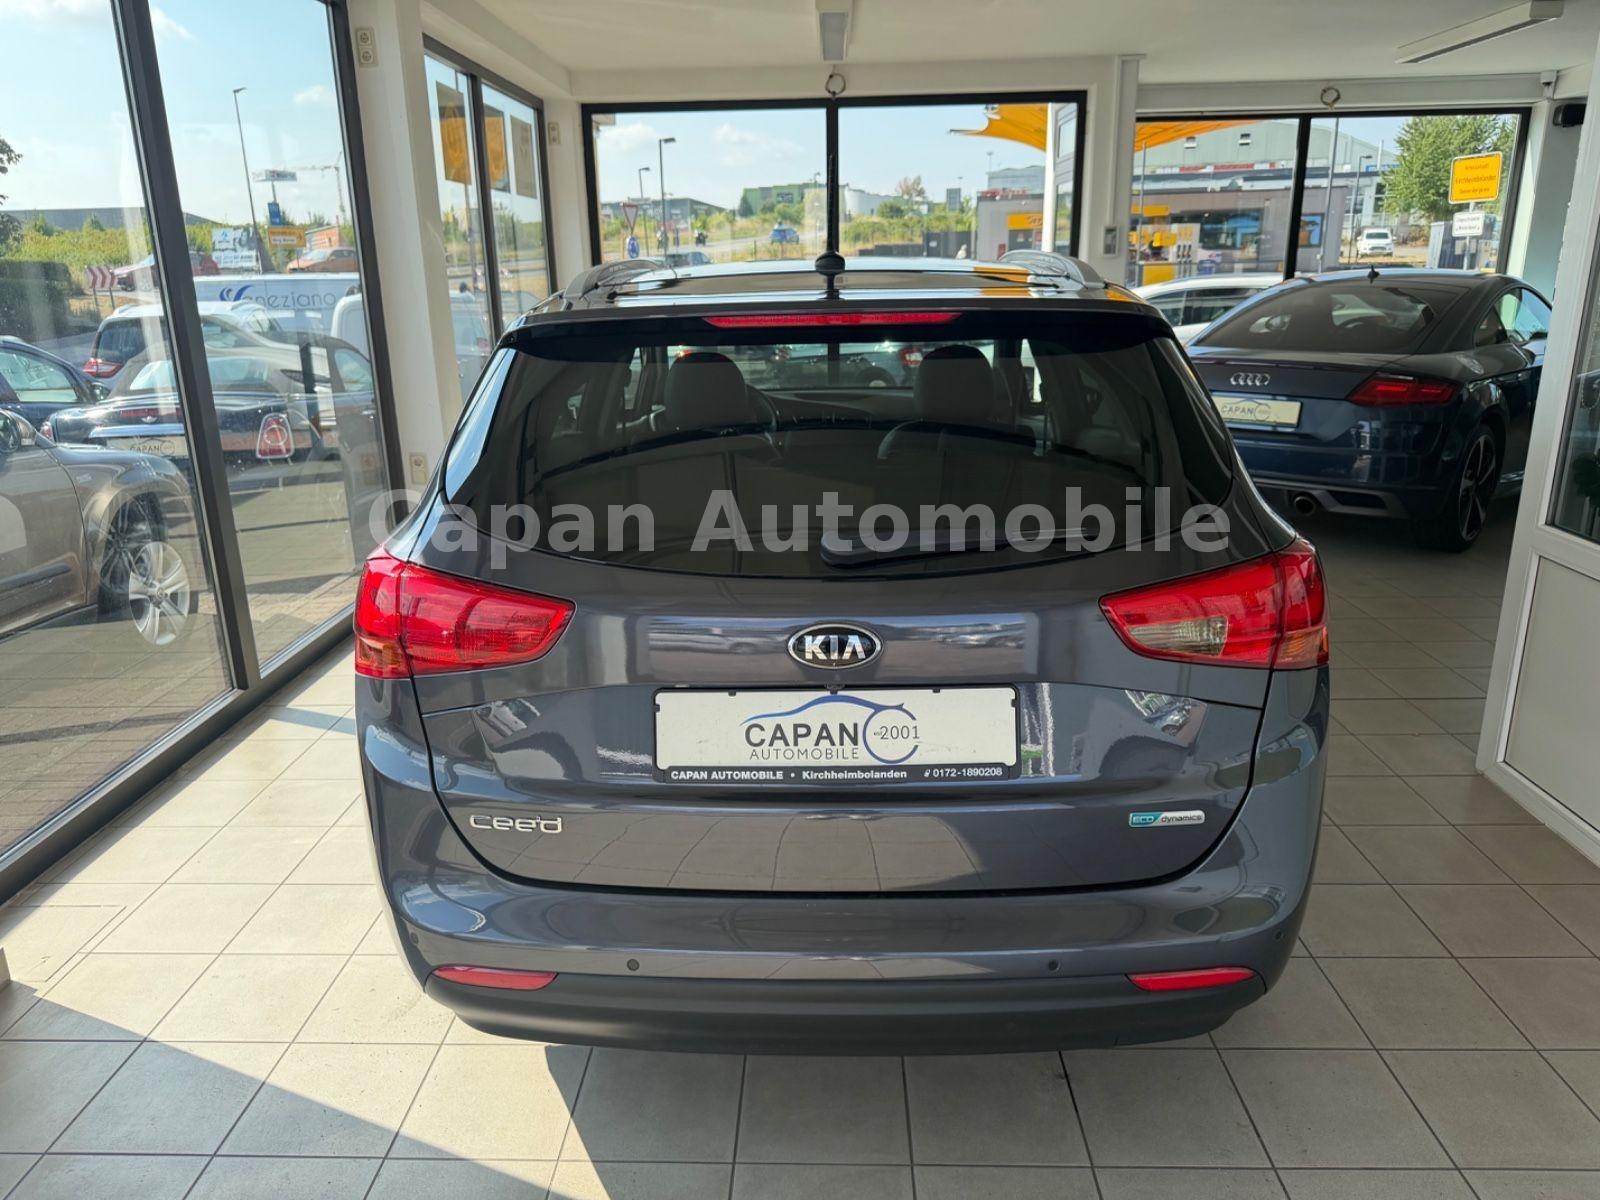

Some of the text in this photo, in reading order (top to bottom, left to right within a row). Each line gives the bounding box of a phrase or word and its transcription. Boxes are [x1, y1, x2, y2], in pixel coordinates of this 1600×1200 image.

[804, 634, 866, 660] KIA
[744, 722, 858, 747] CAPAN
[880, 725, 920, 740] 2001
[749, 748, 860, 761] AUTOMOBILE
[670, 767, 1003, 780] CAPAN AUTOMOBILE Kirchheimbolanden 0172-1890208
[1160, 813, 1203, 824] dynamics
